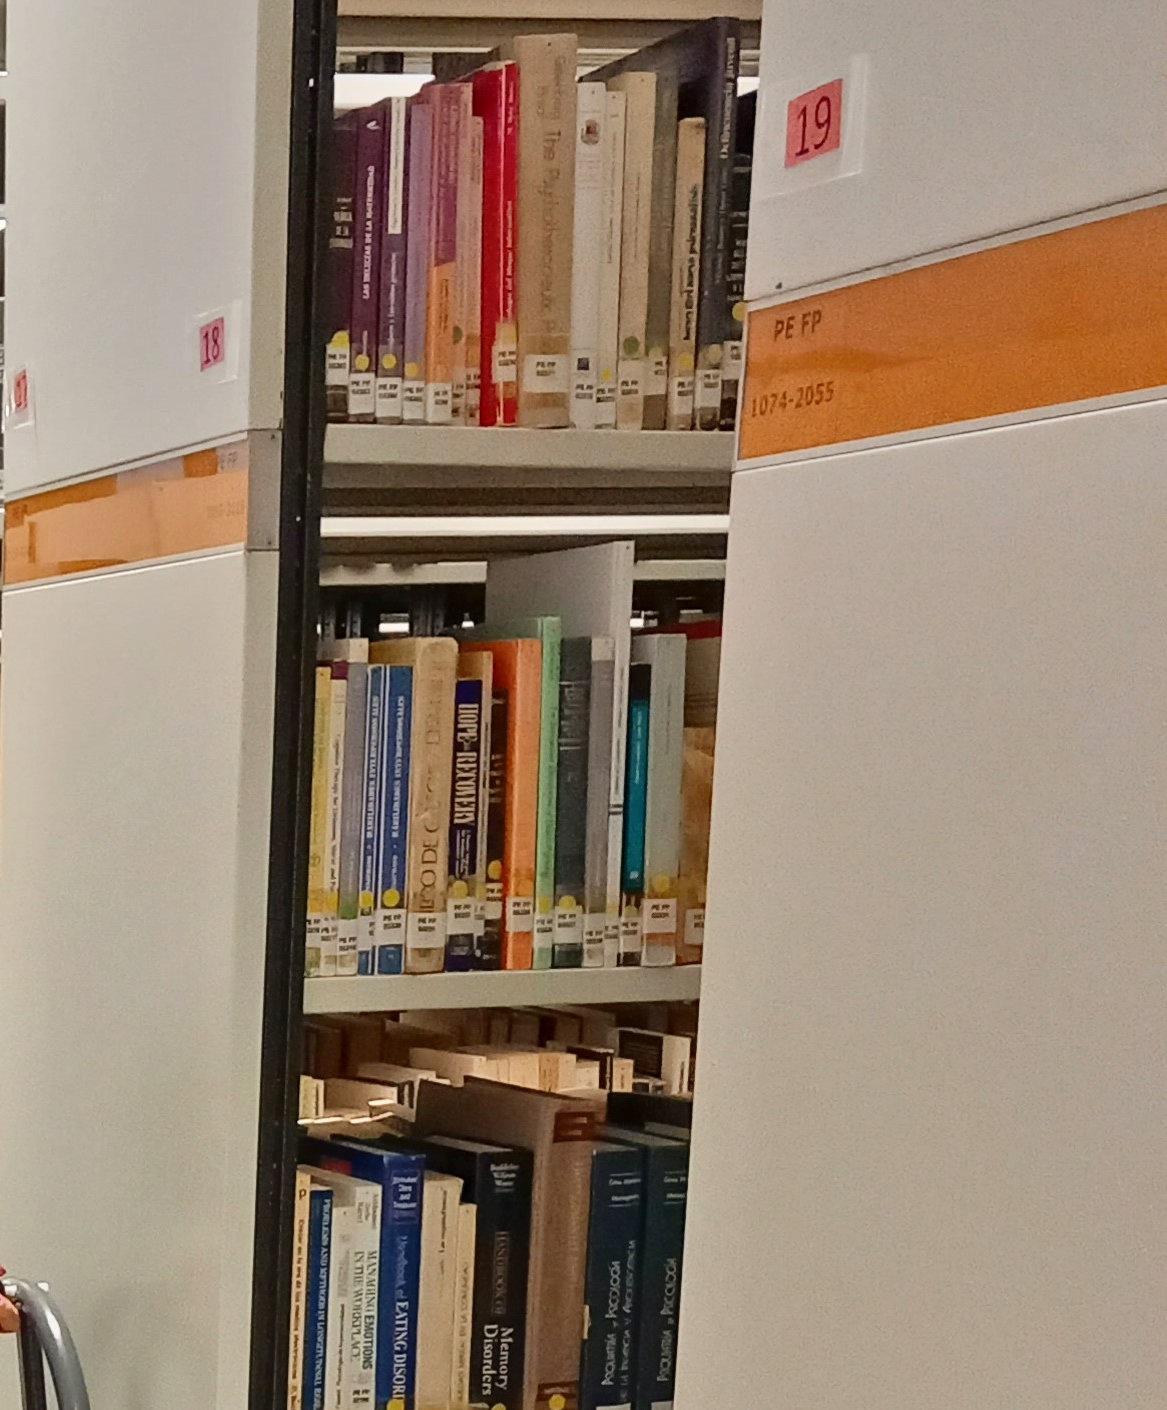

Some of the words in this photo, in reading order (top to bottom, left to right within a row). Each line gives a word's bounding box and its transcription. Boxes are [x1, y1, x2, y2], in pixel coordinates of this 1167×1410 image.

[544, 130, 561, 161] The
[794, 95, 832, 157] 19
[203, 326, 221, 365] 18
[774, 316, 796, 341] PE
[801, 309, 823, 335] FP
[453, 751, 478, 827] RECOVERY
[321, 1198, 330, 1246] PROBLEMS
[321, 1247, 329, 1266] AND
[353, 1264, 364, 1288] THE
[354, 1250, 363, 1262] IN
[365, 1250, 378, 1313] MANAGING
[351, 1289, 363, 1363] WORKPLACE
[363, 1314, 375, 1370] EMOTIONS
[393, 1300, 409, 1351] EATING
[481, 1323, 499, 1396] Disorders
[495, 1326, 514, 1390] Memory
